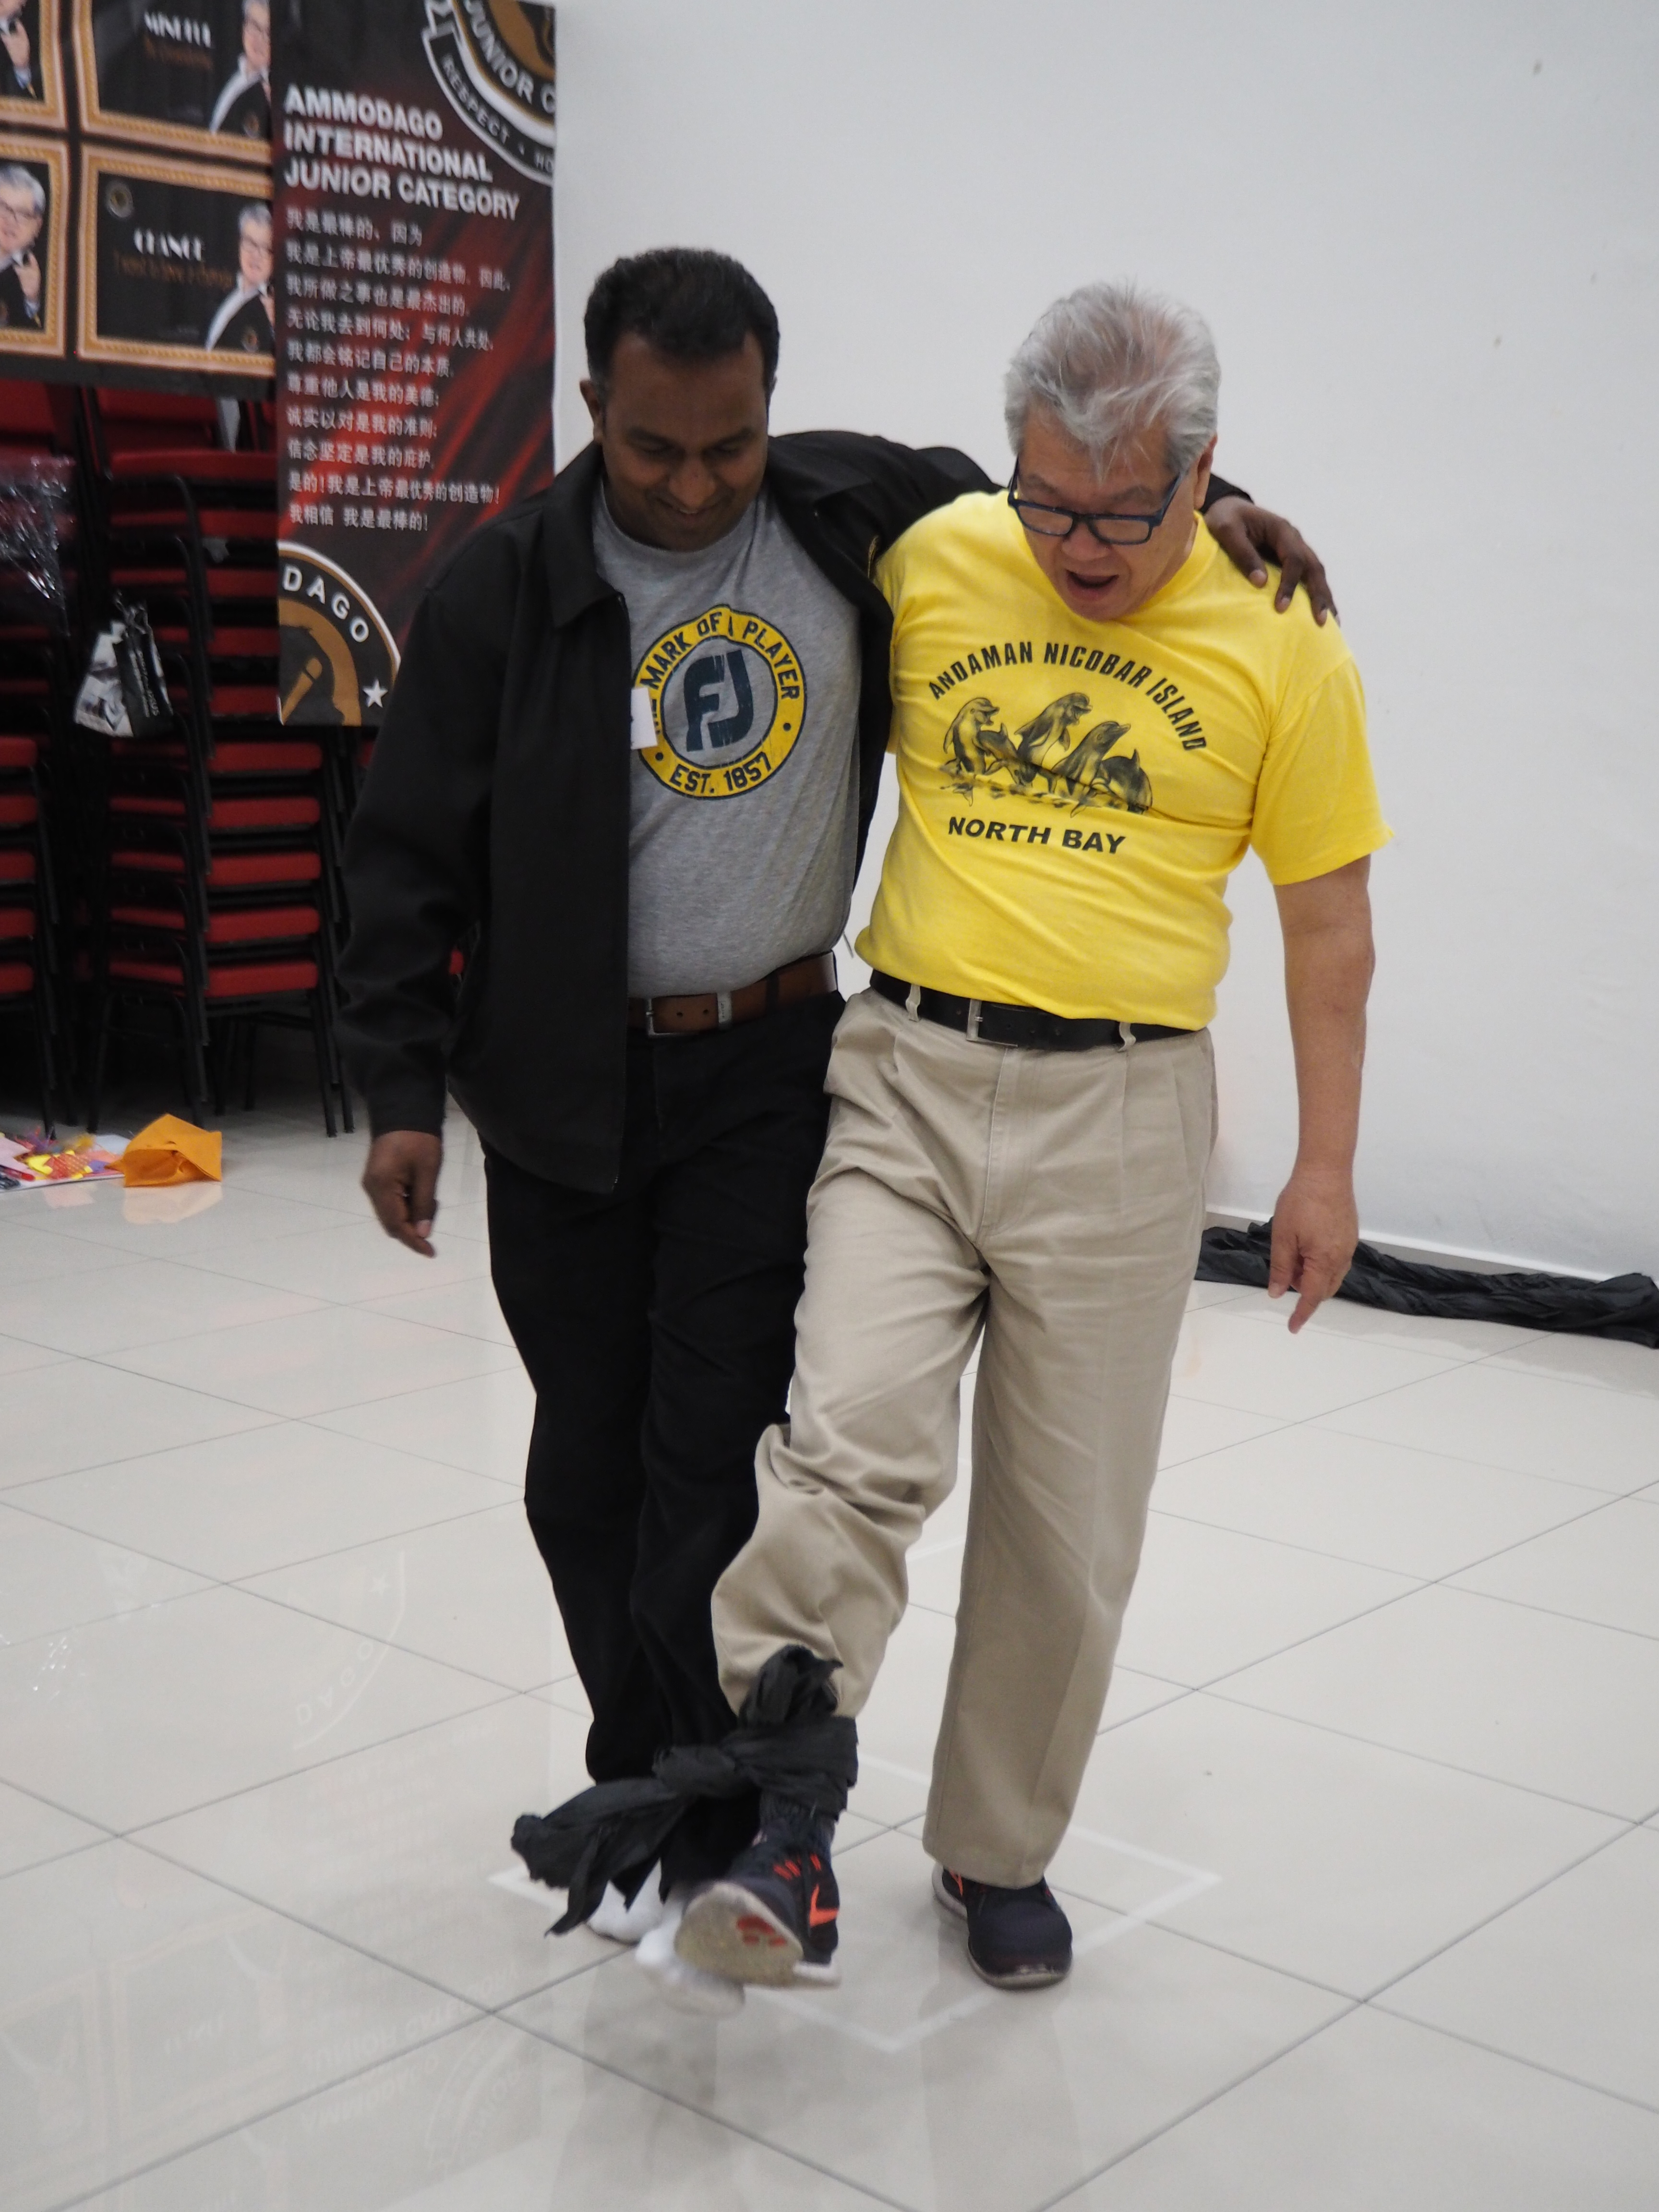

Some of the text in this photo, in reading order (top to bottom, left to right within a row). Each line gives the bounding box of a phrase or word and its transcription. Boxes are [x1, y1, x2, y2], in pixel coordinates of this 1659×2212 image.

[283, 84, 443, 141] AMMODAGO
[441, 54, 510, 145] RESPECT
[283, 120, 493, 182] INTERNATIONAL
[284, 157, 520, 220] JUNIOR CATEGORY
[282, 565, 369, 642] DAGO
[640, 612, 800, 699] MARK OF PLAYER
[684, 649, 754, 752] FJ
[928, 641, 1207, 751] ANDAMAN NICOBAR ISLAND
[669, 752, 771, 793] EST. 1857
[948, 817, 1126, 854] NORTH BAY
